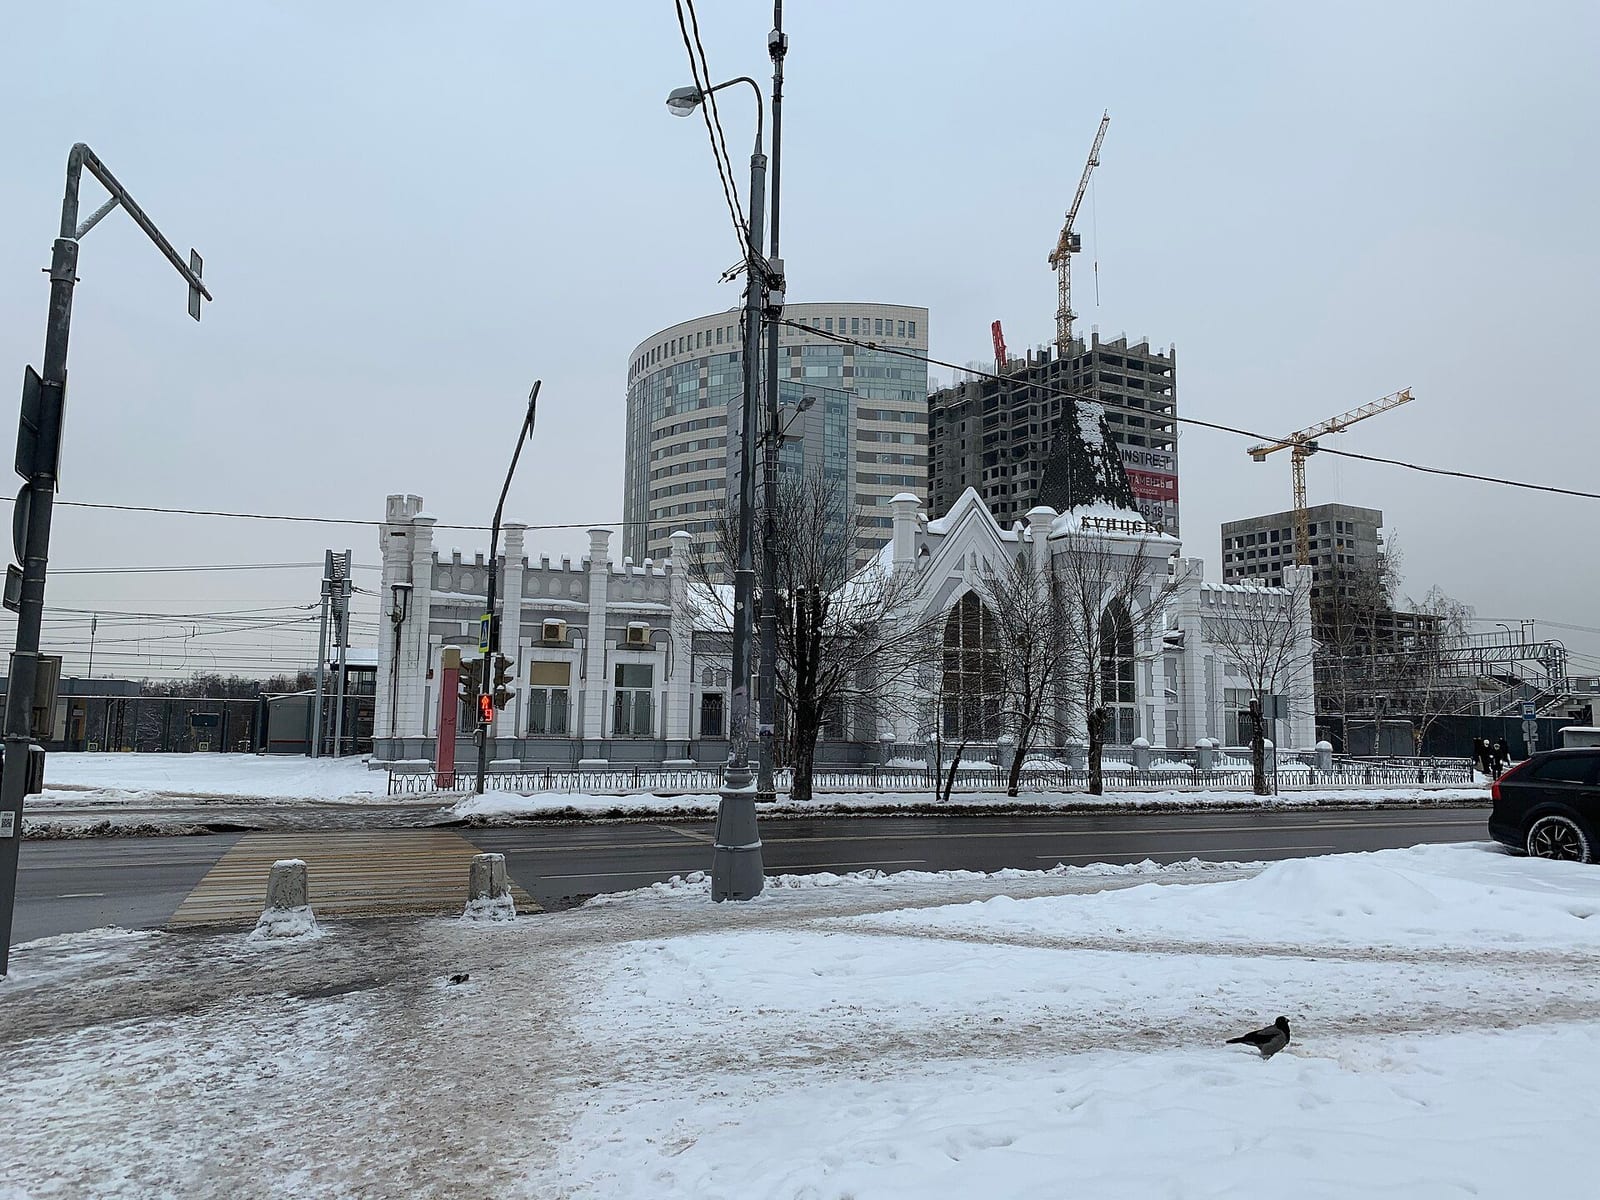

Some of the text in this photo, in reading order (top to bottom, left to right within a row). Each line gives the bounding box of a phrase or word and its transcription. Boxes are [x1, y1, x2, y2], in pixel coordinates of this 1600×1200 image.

[1121, 449, 1171, 467] INSTREET
[1139, 504, 1163, 518] 48-18
[485, 709, 492, 721] 9
